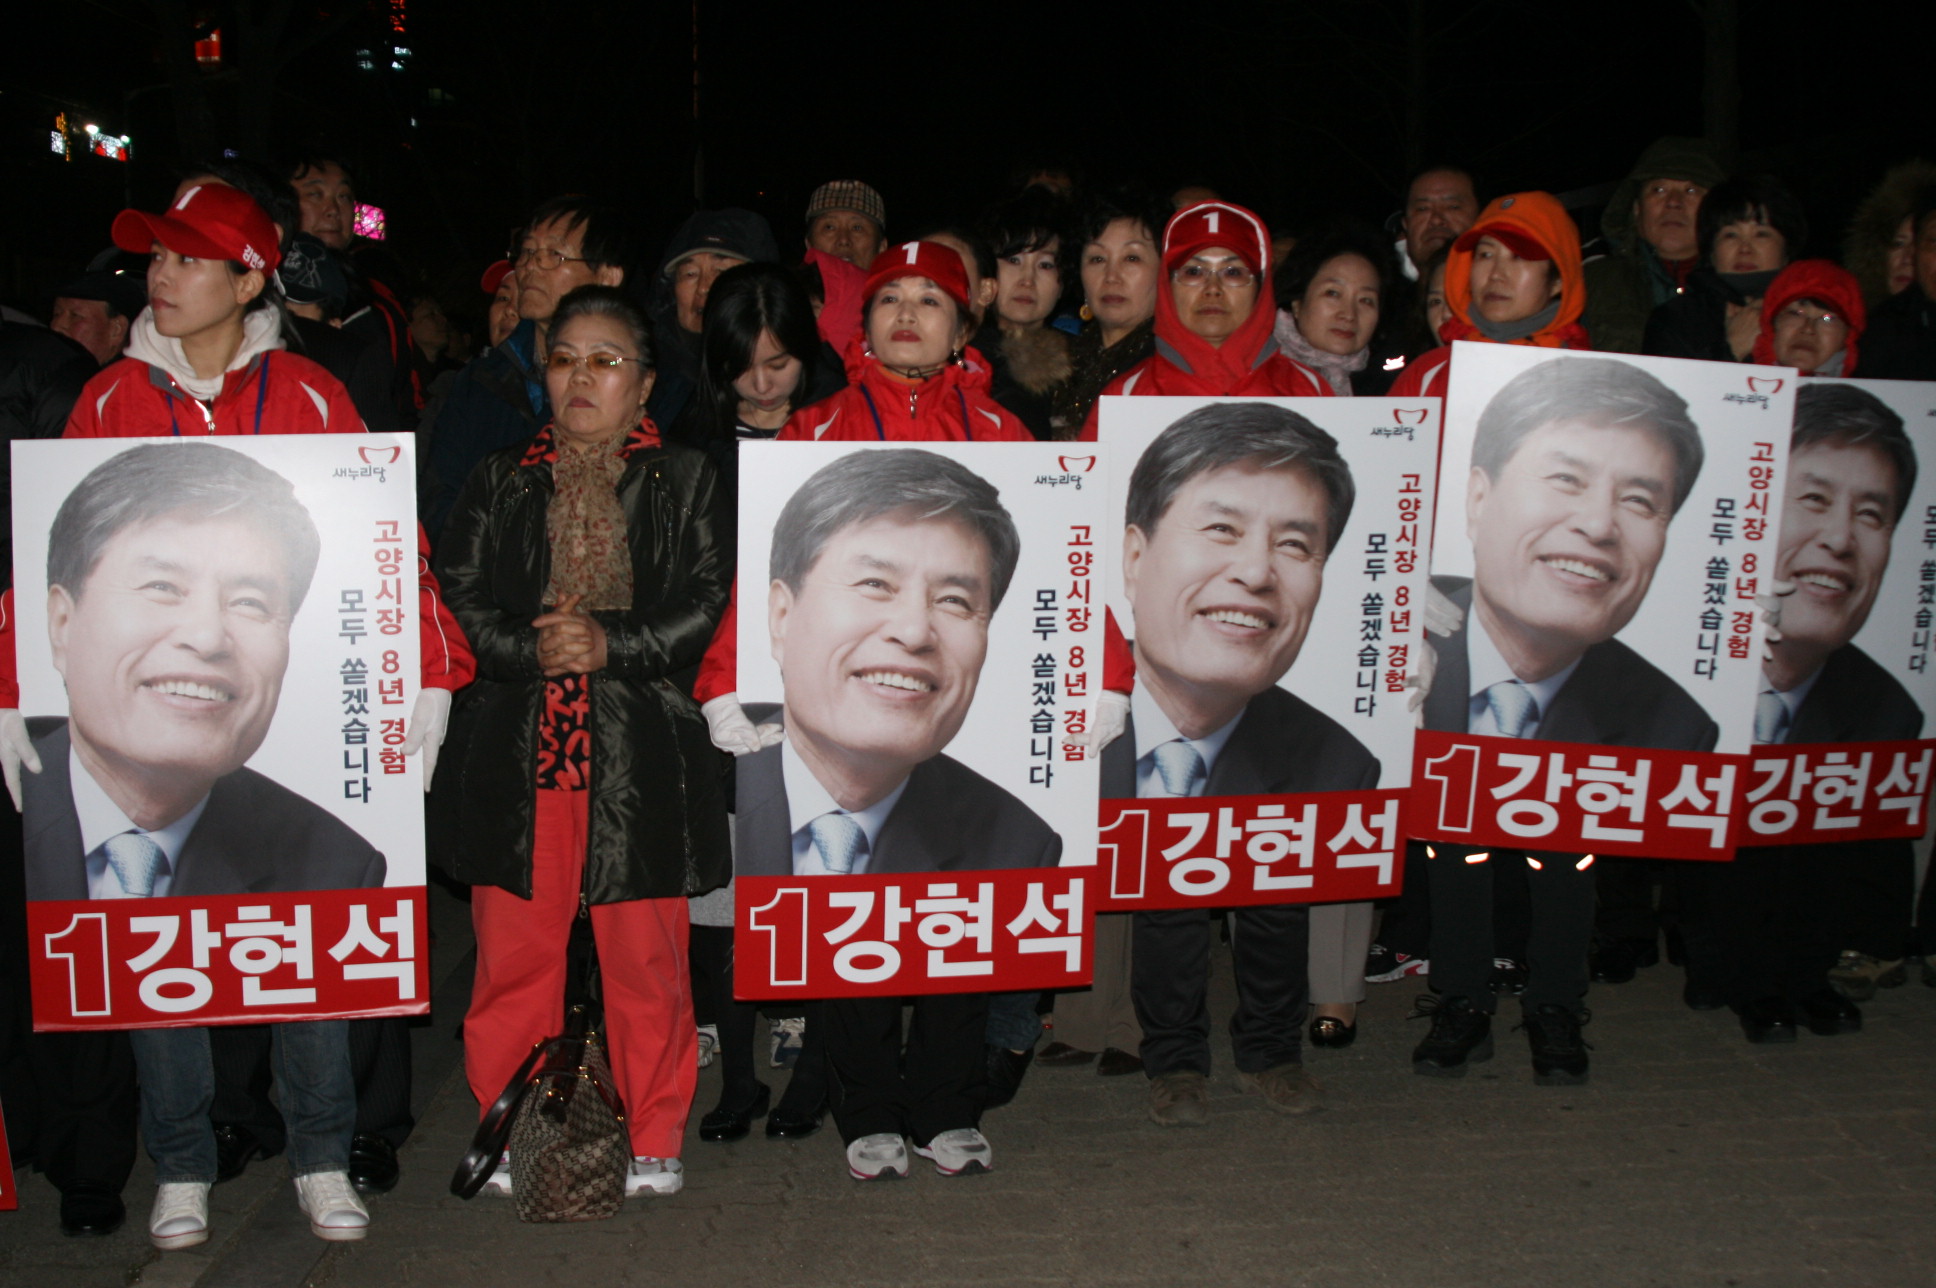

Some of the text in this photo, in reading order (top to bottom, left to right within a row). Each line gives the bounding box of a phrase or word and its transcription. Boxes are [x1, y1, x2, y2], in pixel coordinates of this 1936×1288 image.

[902, 241, 920, 265] 1
[1202, 211, 1220, 234] 1
[1370, 425, 1415, 441] 새누리당
[1723, 393, 1770, 410] 새누리당
[332, 465, 386, 483] 새누리당
[1034, 473, 1082, 490] 새누리당
[1066, 525, 1093, 632] 고양시장
[1385, 474, 1422, 692] 고양시장 8년 경험
[1693, 498, 1736, 680] 모두 쏟겠습니다
[1727, 442, 1775, 659] 고양시장 8년 경험
[373, 520, 406, 774] 고양시장 8년 경험
[1064, 646, 1087, 697] 8년
[1354, 533, 1388, 717] 모두 쏟겠습니다
[338, 589, 372, 803] 모두 쏟겠습니다
[1029, 589, 1058, 789] 모두 쏟겠습니다
[1424, 743, 1737, 849] 1 강현석
[1745, 748, 1934, 834] 강현석
[1161, 799, 1400, 896] 강현석
[44, 899, 416, 1017] 1 강현석
[749, 878, 1084, 987] 1 강현석
